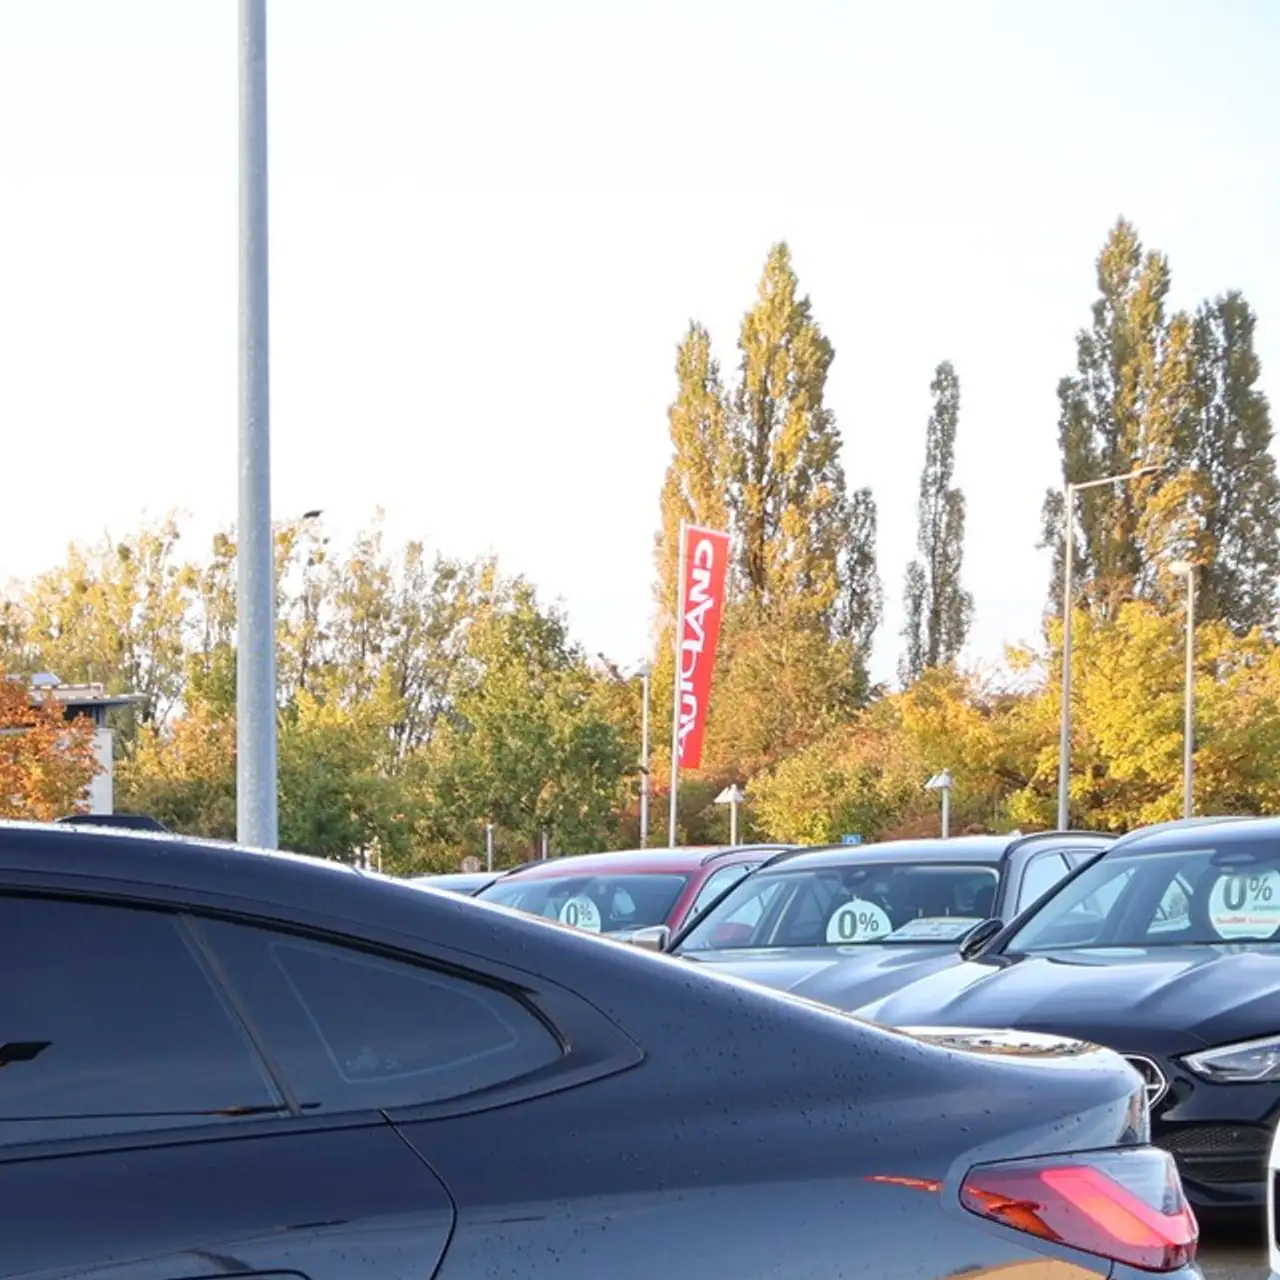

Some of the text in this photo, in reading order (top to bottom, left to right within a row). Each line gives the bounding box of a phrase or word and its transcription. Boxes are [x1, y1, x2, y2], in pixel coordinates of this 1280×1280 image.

[1223, 875, 1273, 911] 0%
[565, 902, 593, 926] 0%
[838, 909, 880, 940] 0%
